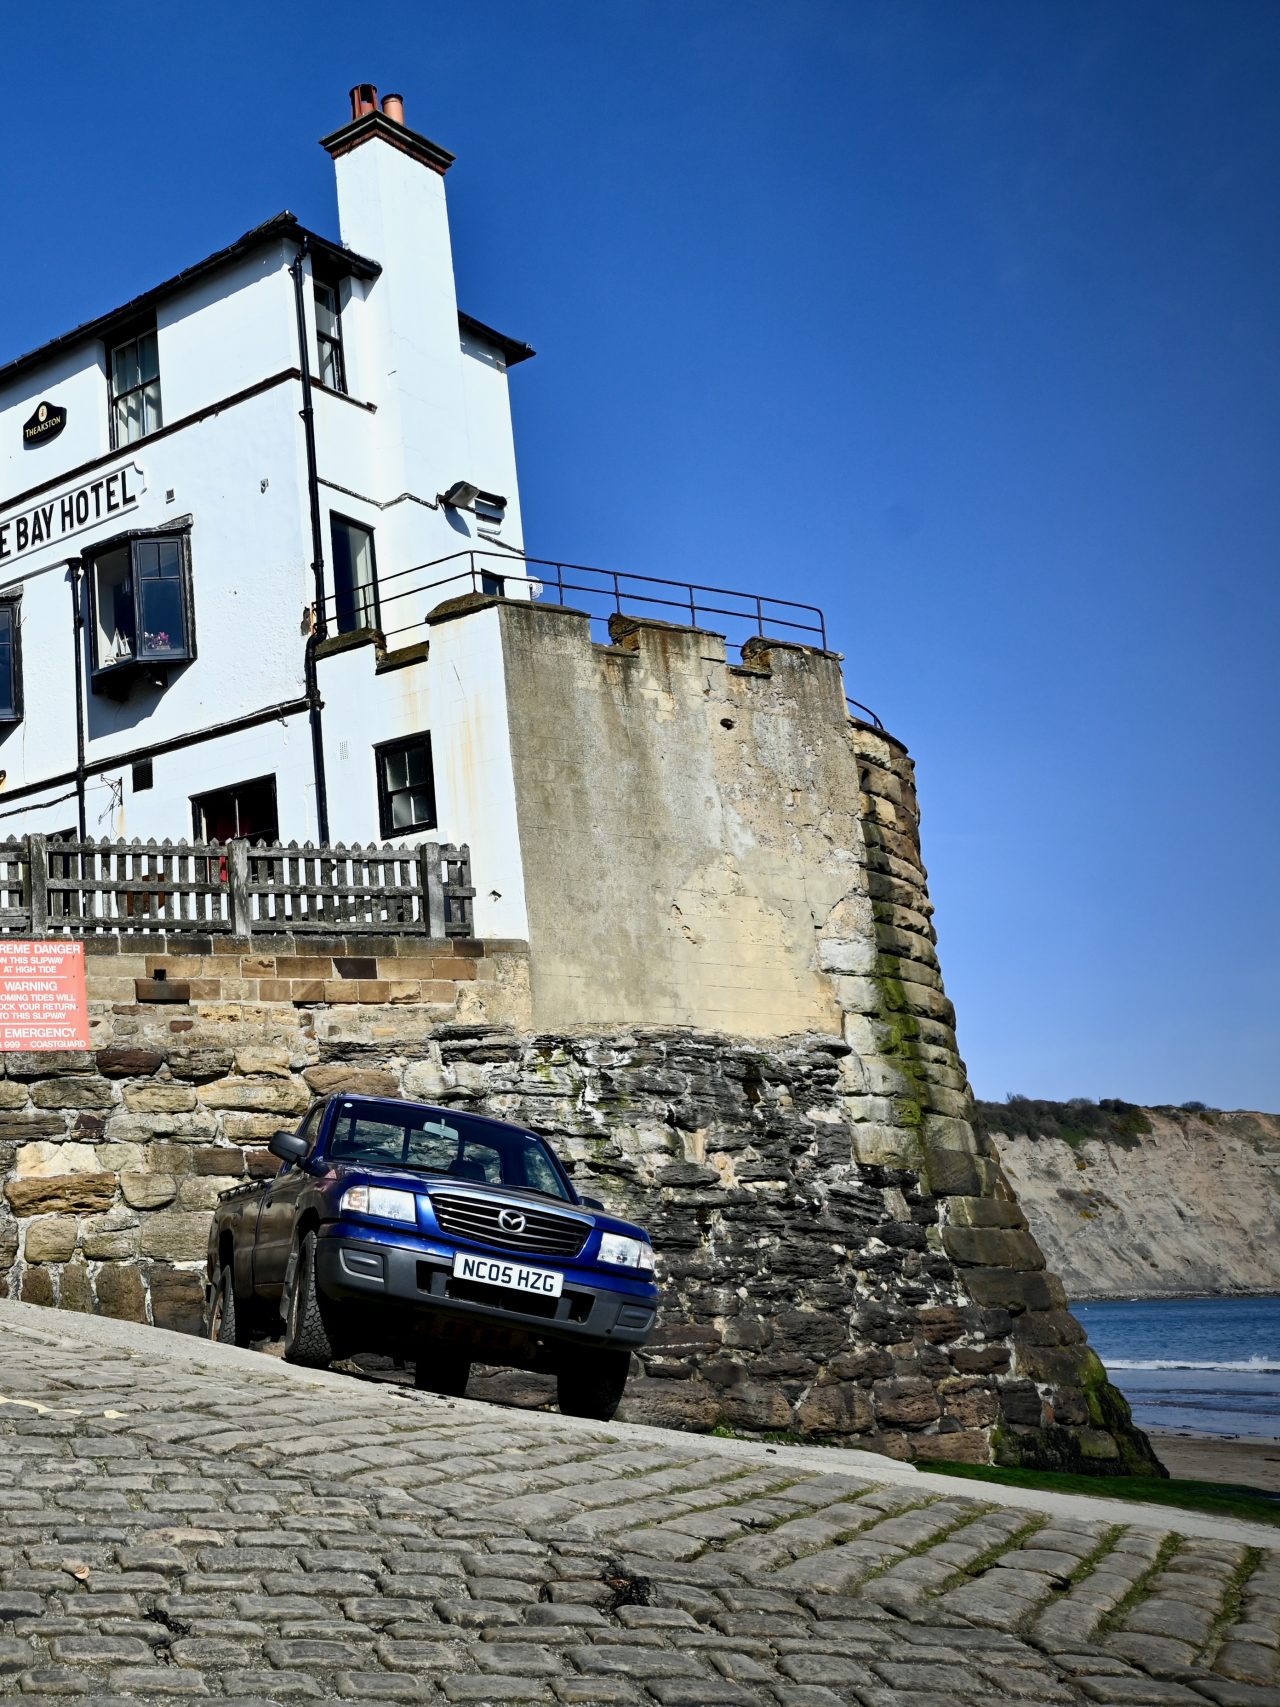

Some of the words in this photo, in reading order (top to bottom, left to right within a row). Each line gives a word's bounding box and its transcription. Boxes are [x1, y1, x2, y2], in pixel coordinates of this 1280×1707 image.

[25, 415, 61, 438] THEAKSTON
[16, 503, 54, 552] BAY
[60, 470, 136, 534] HOTEL
[34, 944, 81, 954] DANGER
[4, 982, 57, 991] WARNING
[5, 1028, 76, 1038] EMERGENCY
[5, 1041, 20, 1049] 999
[30, 1040, 86, 1048] COASTGUARD
[462, 1258, 513, 1284] NC05
[517, 1269, 555, 1292] HZG
